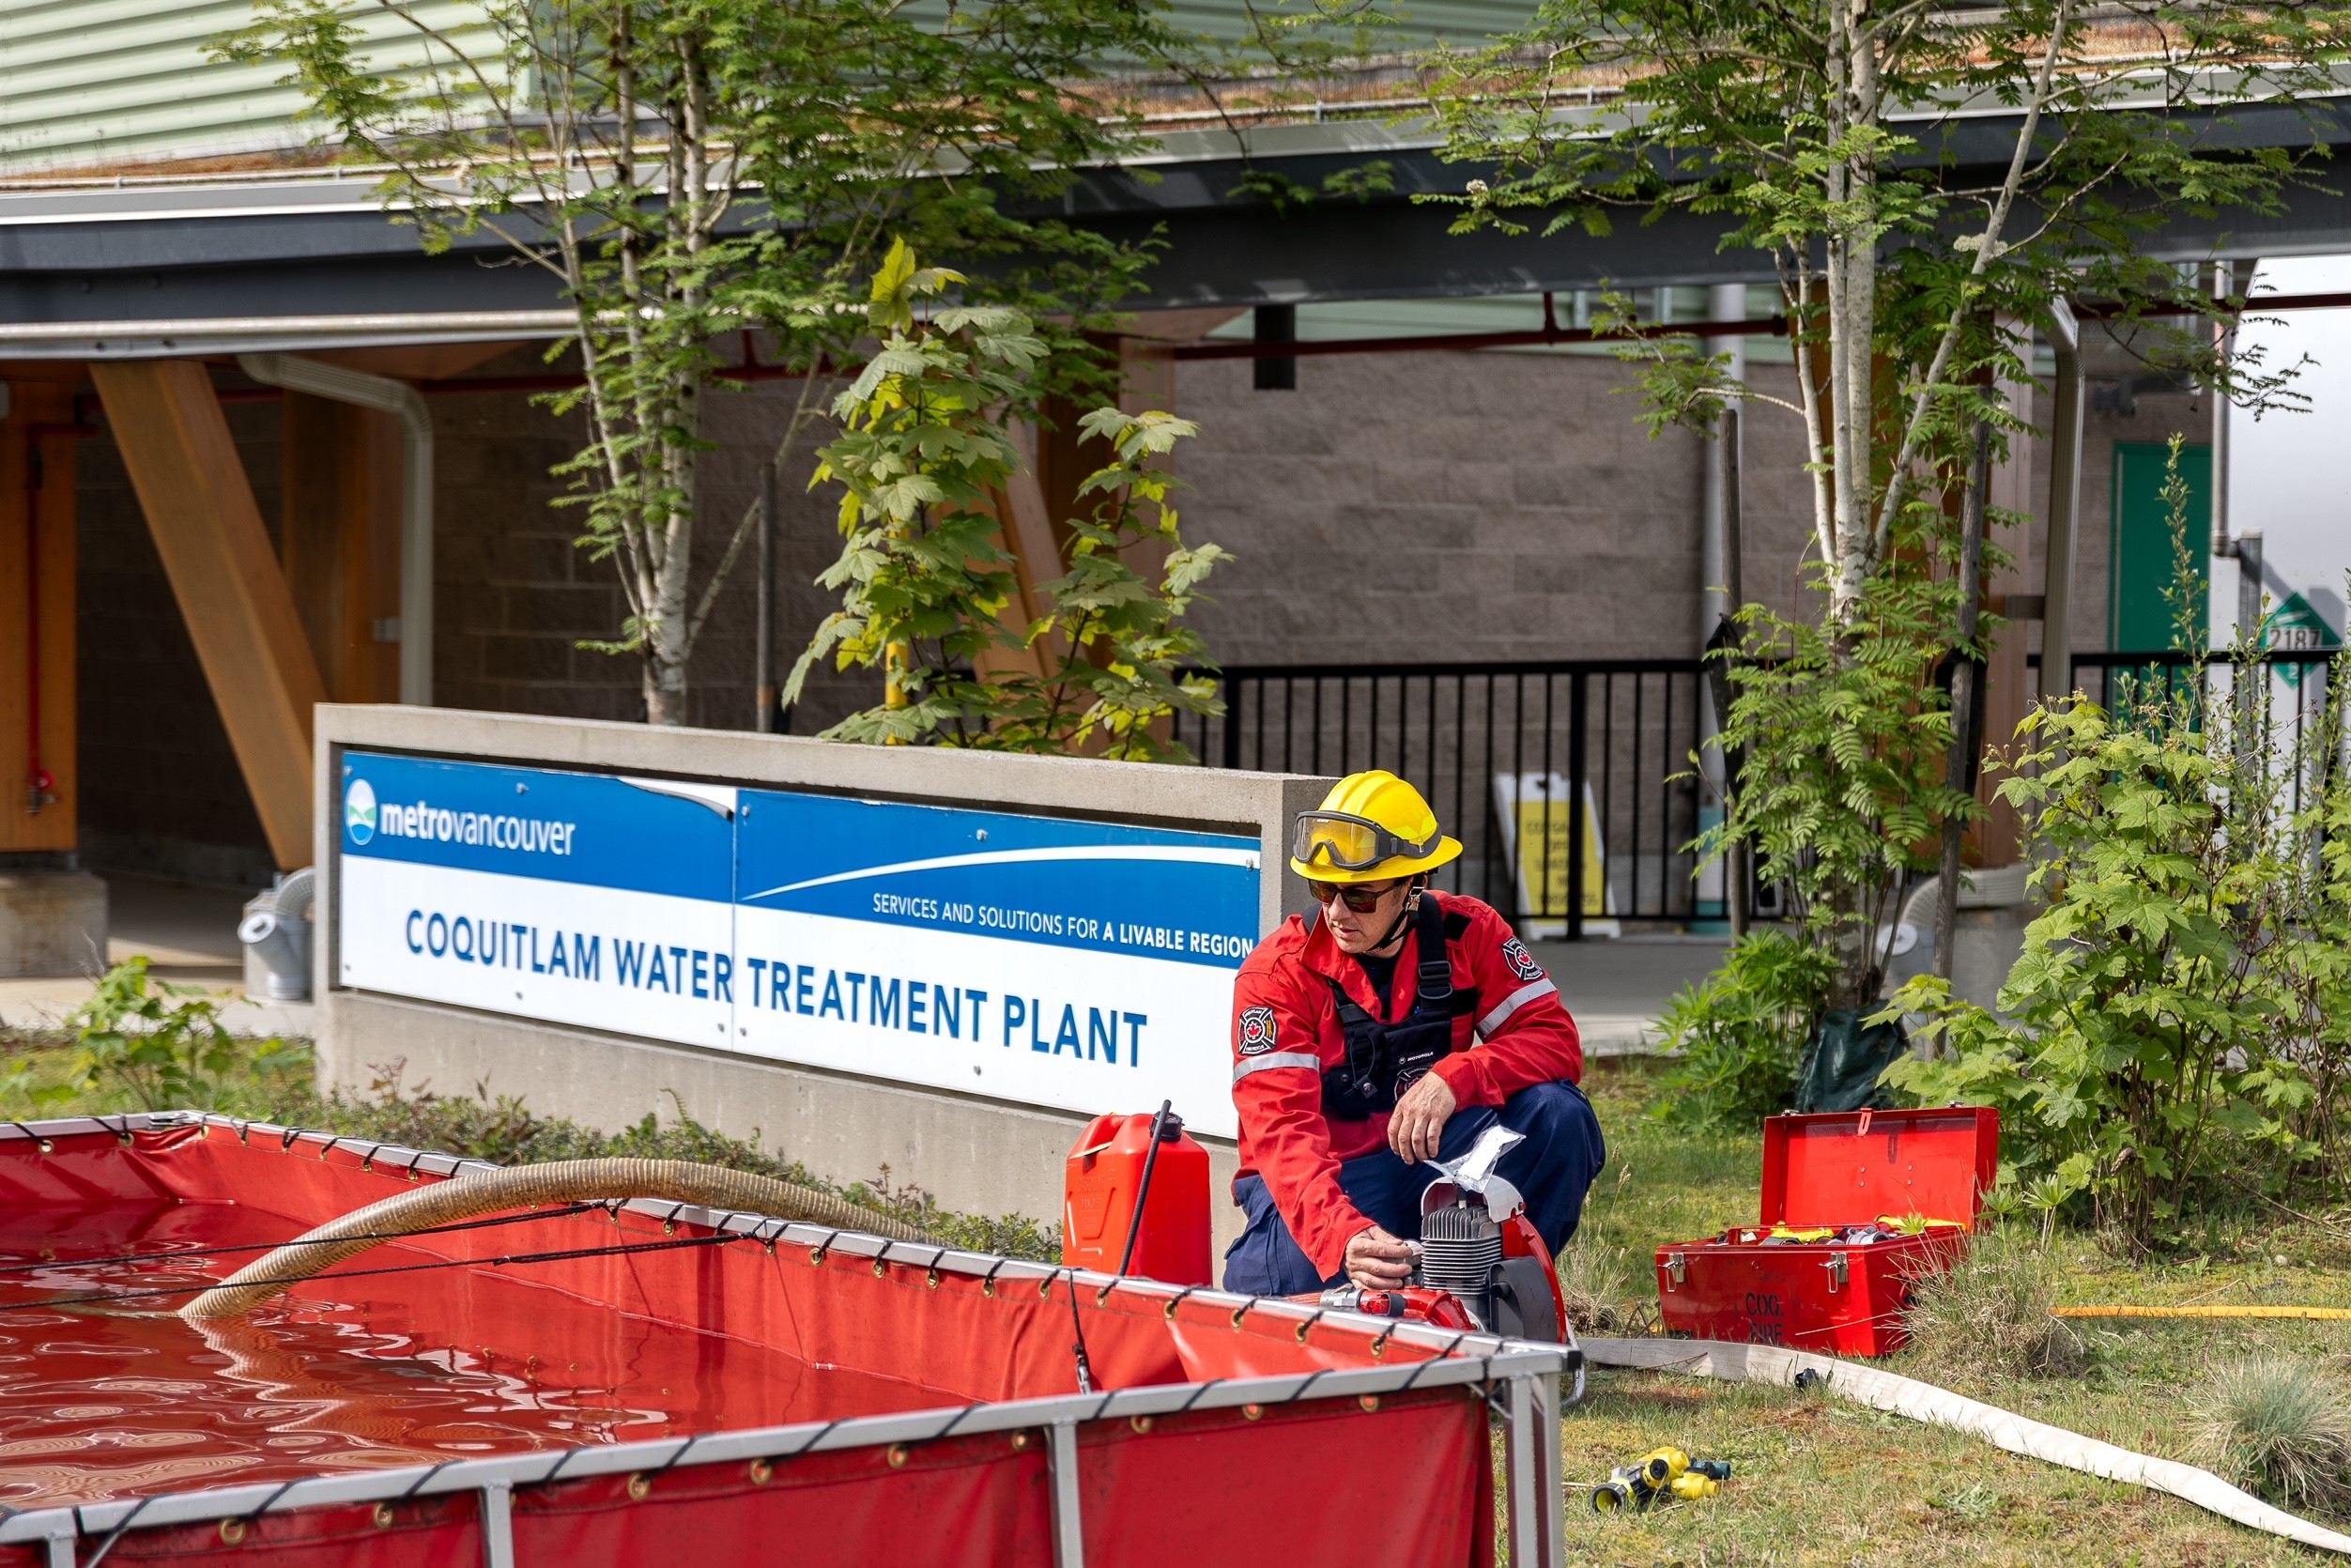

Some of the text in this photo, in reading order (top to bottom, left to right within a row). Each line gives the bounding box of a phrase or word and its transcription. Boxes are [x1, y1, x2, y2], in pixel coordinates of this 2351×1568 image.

[2269, 629, 2321, 651] 2187
[873, 892, 1253, 959] SERVICES AND SOLUTIONS FOR A LIVABLE REGION
[406, 909, 1148, 1068] COQUITLAM WATER TREATMENT PLANT
[1407, 1052, 1434, 1062] MOTOROLA
